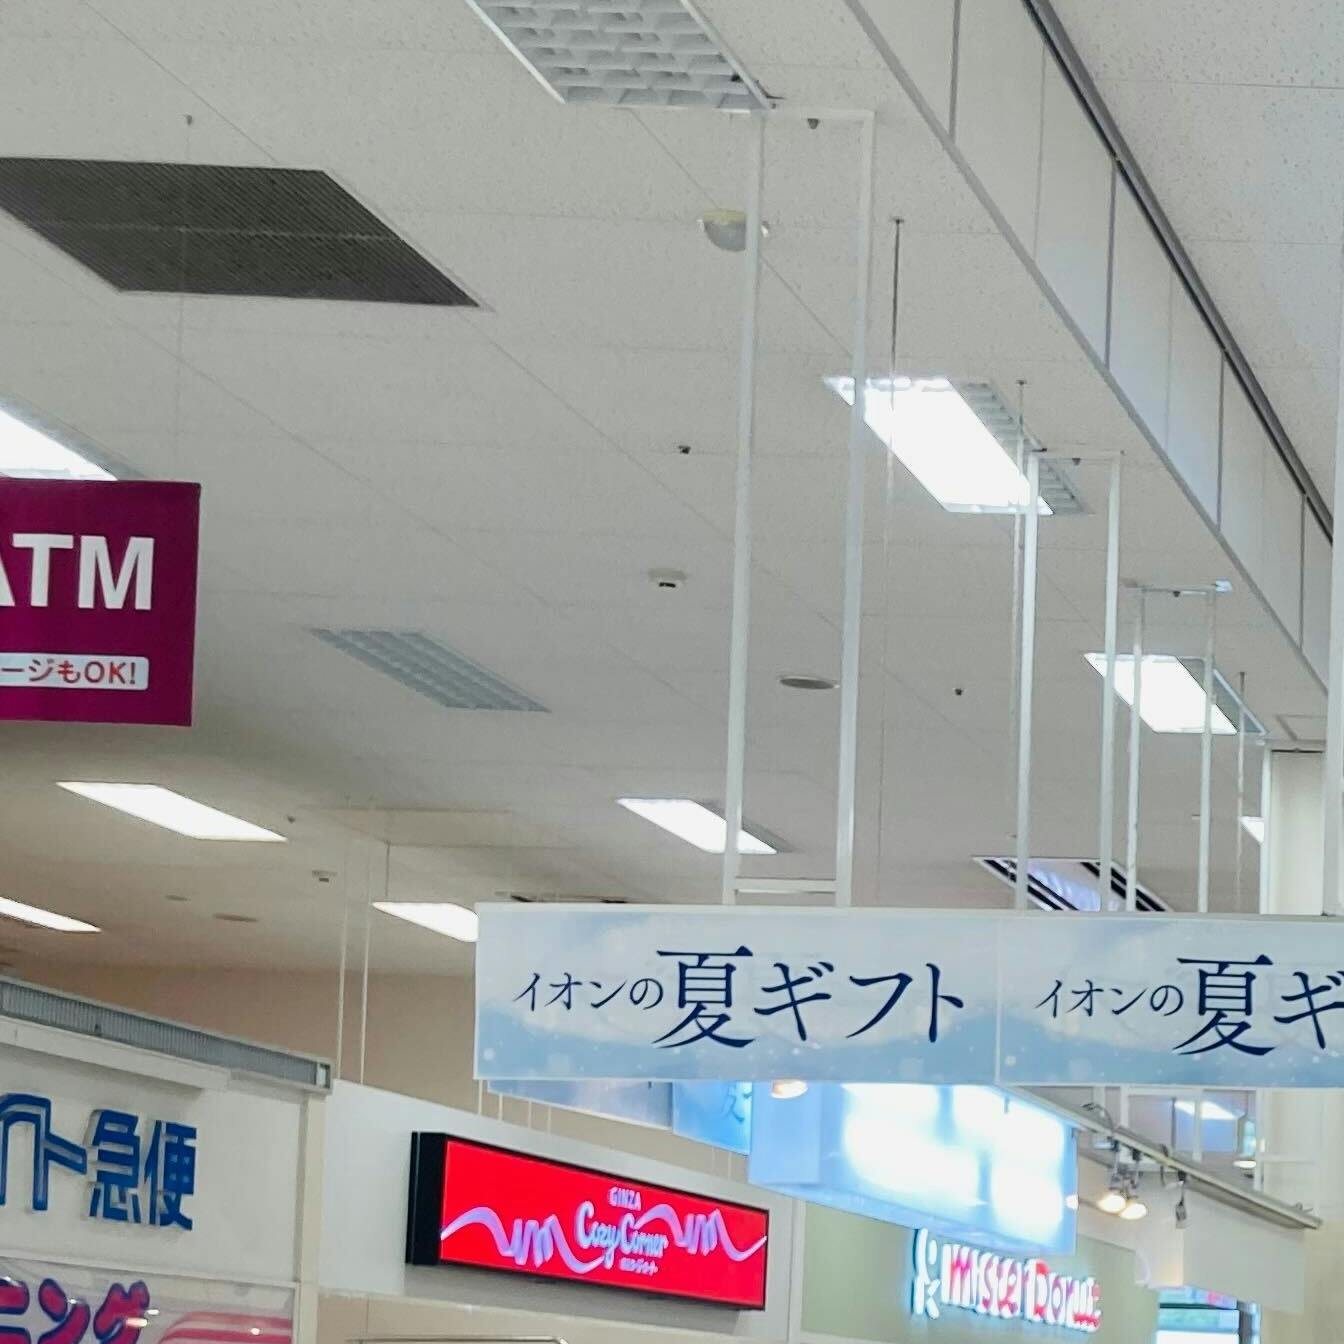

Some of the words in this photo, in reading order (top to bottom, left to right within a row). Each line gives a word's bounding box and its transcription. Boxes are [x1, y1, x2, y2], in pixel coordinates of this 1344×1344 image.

[514, 944, 965, 1049] イオンの夏ギフト
[0, 1093, 197, 1231] ト急便
